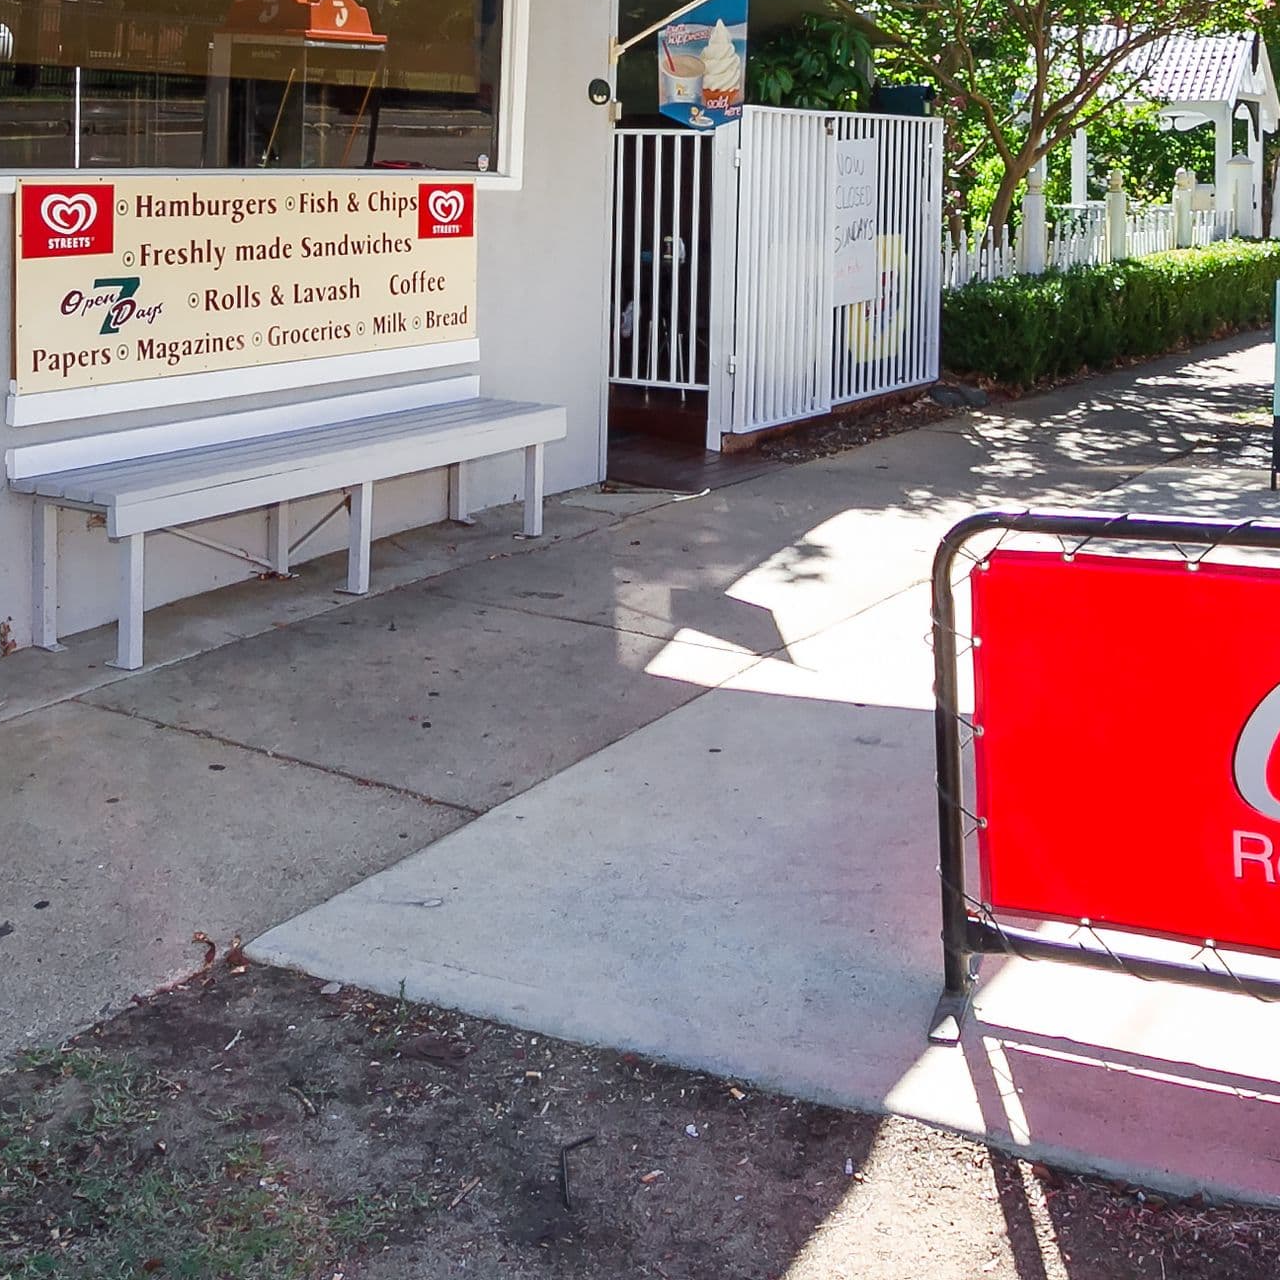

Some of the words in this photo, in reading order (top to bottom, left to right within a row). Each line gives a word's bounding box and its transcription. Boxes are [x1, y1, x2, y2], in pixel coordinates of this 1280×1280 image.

[135, 191, 277, 224] Hamburgers
[299, 190, 339, 213] Fish
[347, 192, 360, 212] &
[368, 190, 417, 218] Chips
[835, 185, 872, 210] CLOSED
[48, 237, 91, 250] STREETS
[432, 224, 461, 235] STREETS
[834, 218, 874, 254] SUNDAYS
[140, 239, 226, 271] Freshly
[235, 236, 293, 262] made
[301, 232, 412, 259] Sandwiches
[204, 283, 261, 312] Rolls
[270, 284, 284, 306] &
[293, 277, 361, 304] Lavash
[389, 270, 446, 296] Coffee
[60, 290, 116, 317] Open
[93, 276, 140, 335] 7
[111, 299, 164, 326] Days
[32, 347, 112, 378] Papers
[136, 332, 245, 366] Magazines
[268, 321, 351, 347] Groceries
[373, 312, 407, 335] Milk
[425, 305, 468, 329] Bread
